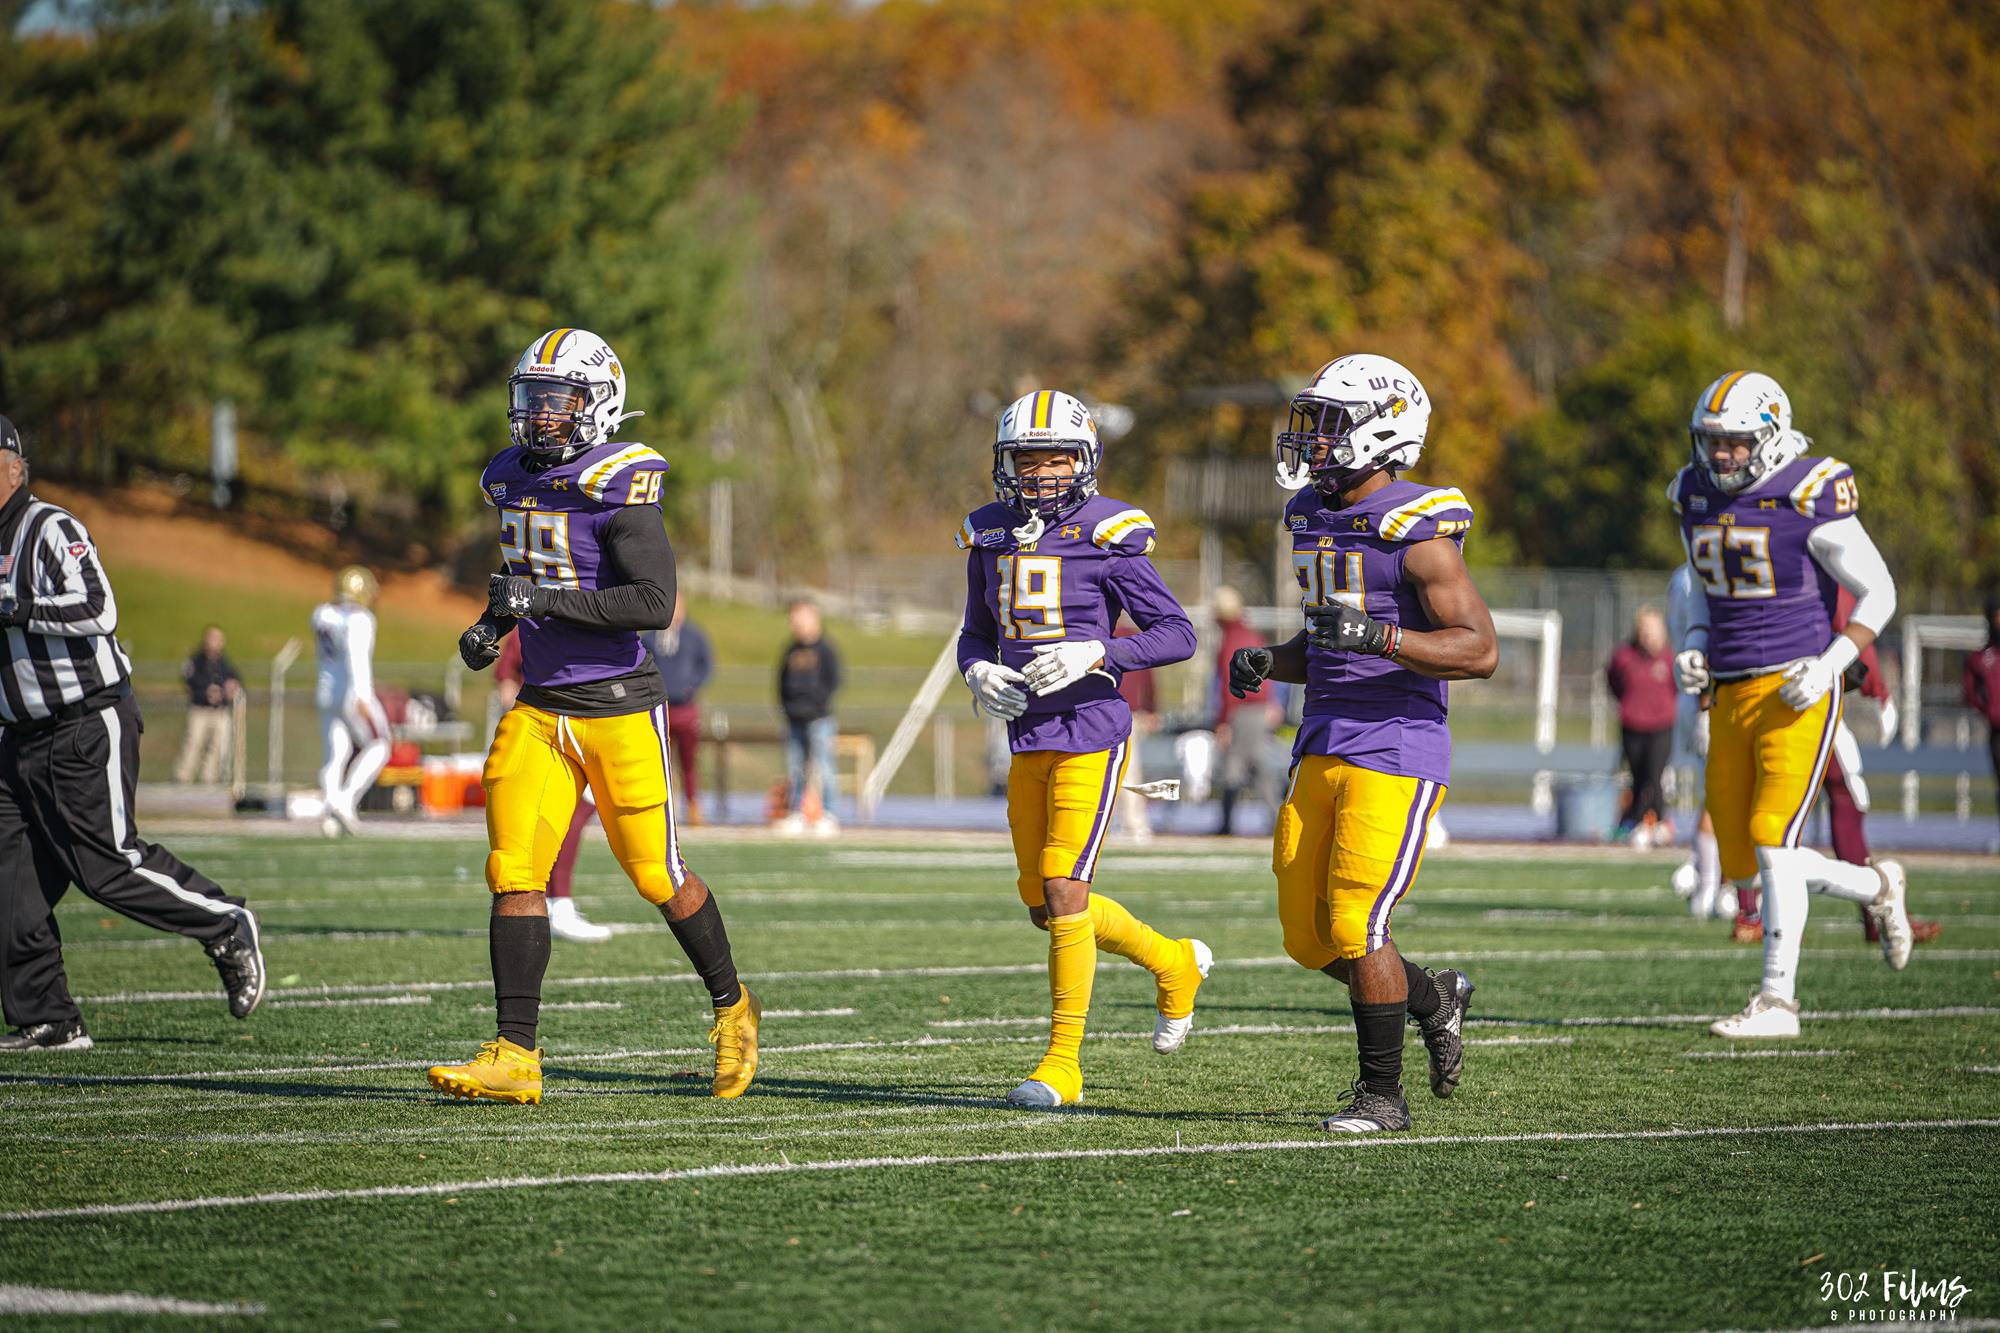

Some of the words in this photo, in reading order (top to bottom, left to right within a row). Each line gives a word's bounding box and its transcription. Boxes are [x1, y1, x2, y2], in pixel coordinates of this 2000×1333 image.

[529, 365, 555, 373] Riddell
[1368, 376, 1422, 406] WCU
[626, 471, 662, 505] 28
[499, 509, 579, 591] 28
[1692, 526, 1776, 598] 93
[996, 556, 1067, 640] 19
